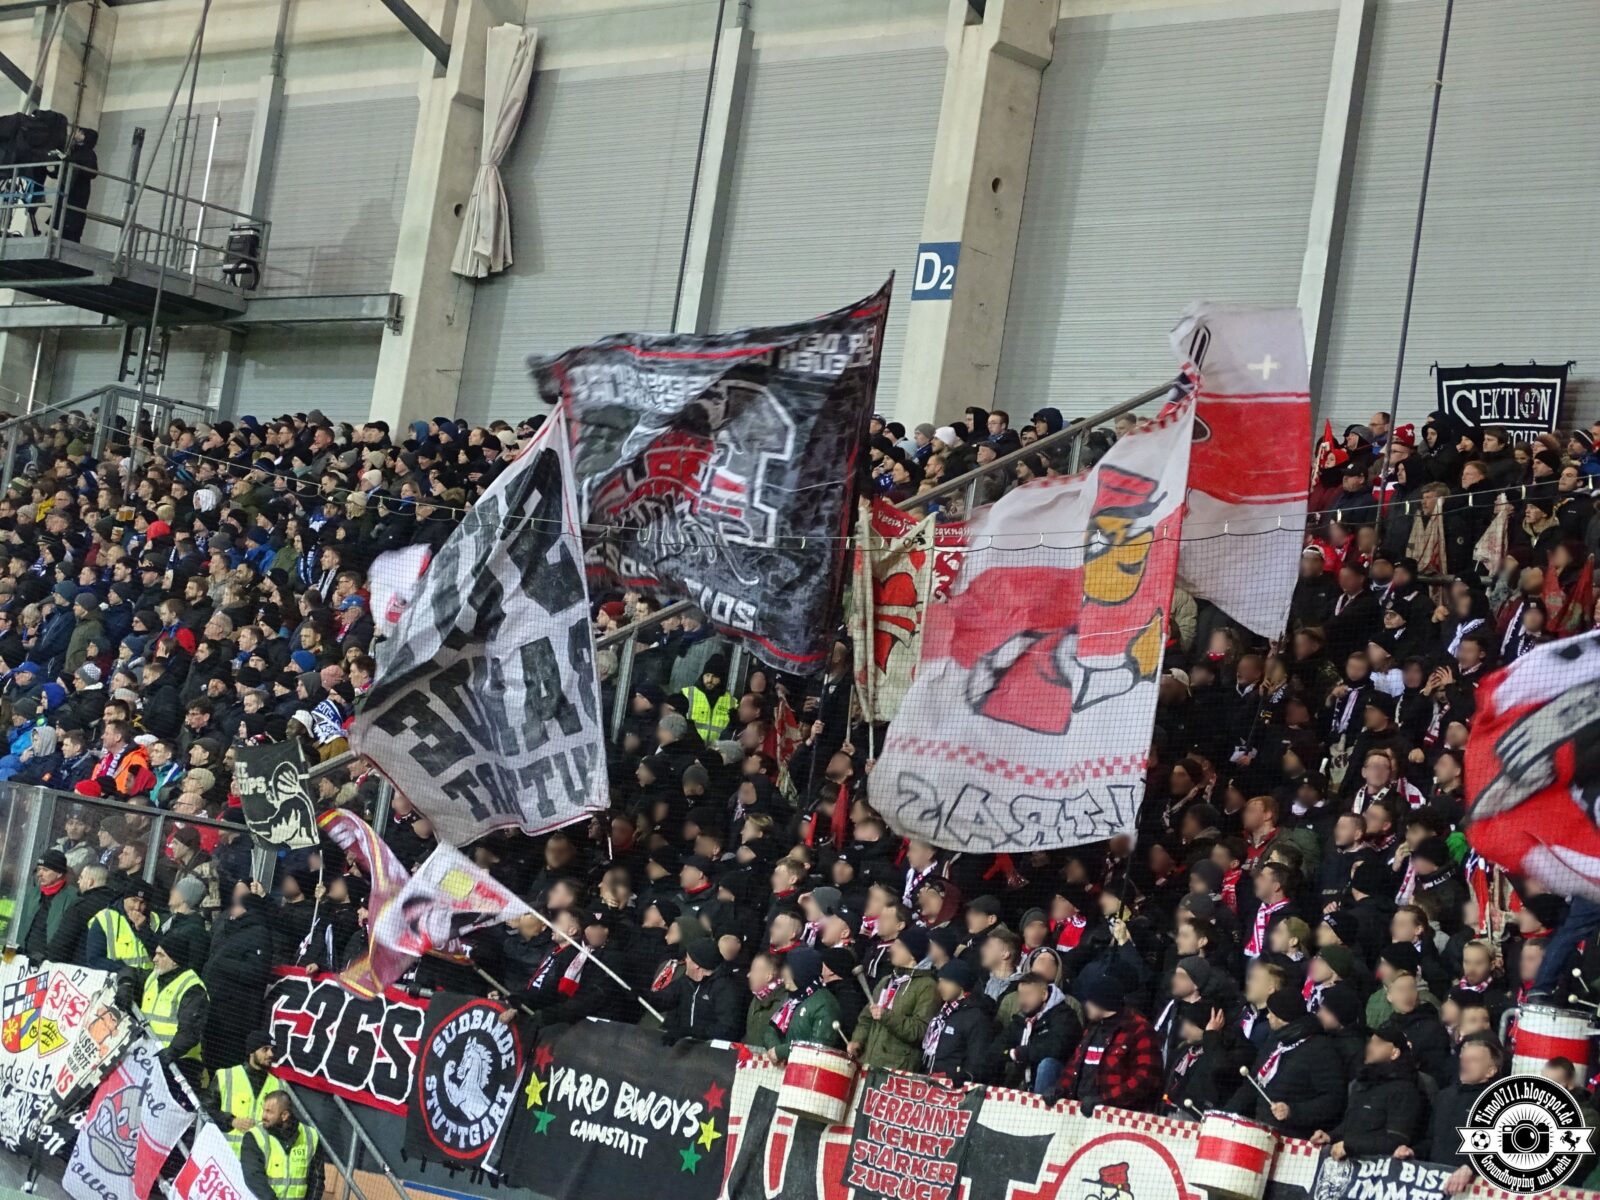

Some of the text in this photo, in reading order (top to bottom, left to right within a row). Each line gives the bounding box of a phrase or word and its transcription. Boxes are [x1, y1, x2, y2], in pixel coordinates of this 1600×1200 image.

[914, 251, 955, 291] D2
[432, 1008, 516, 1071] SÜDBANDE
[425, 1074, 514, 1149] STUTTGART
[547, 1065, 704, 1139] YARD BWOYS
[862, 1087, 973, 1138] VERBANNTE
[879, 1074, 966, 1110] JEDER
[569, 1118, 648, 1159] CANNSTATT
[867, 1118, 956, 1159] KEHRT
[1357, 1157, 1392, 1178] DU
